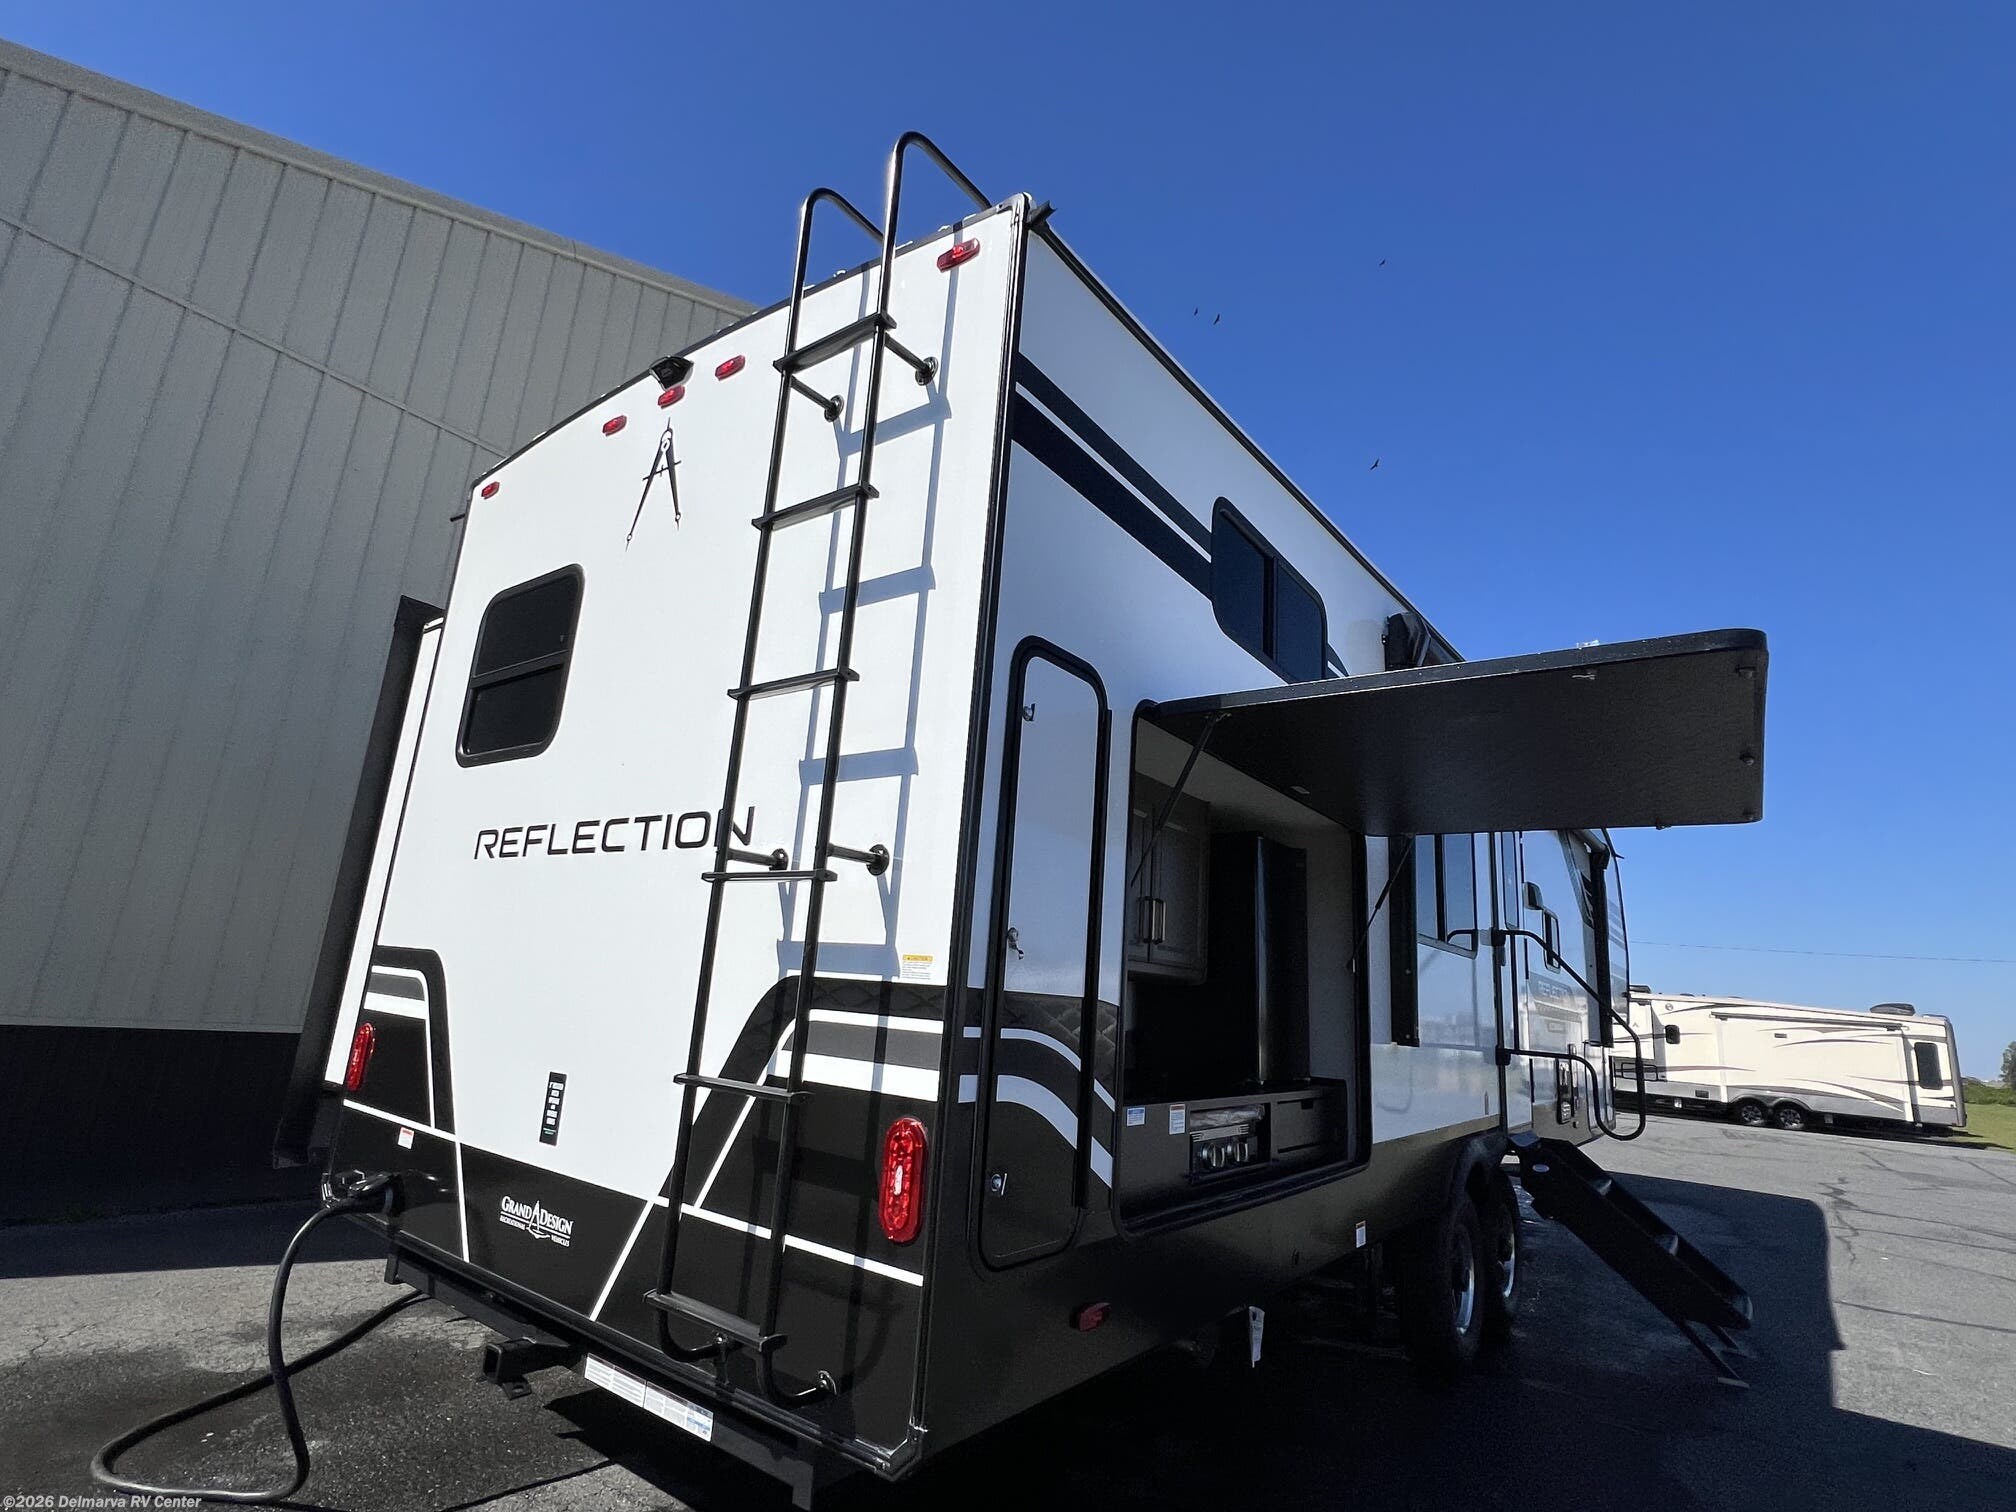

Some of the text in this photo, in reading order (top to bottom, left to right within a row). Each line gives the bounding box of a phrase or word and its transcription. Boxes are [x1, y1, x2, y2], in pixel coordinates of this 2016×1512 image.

[474, 806, 756, 860] REFLECTION
[501, 1195, 532, 1219] GRAND
[539, 1208, 574, 1235] DESIGN
